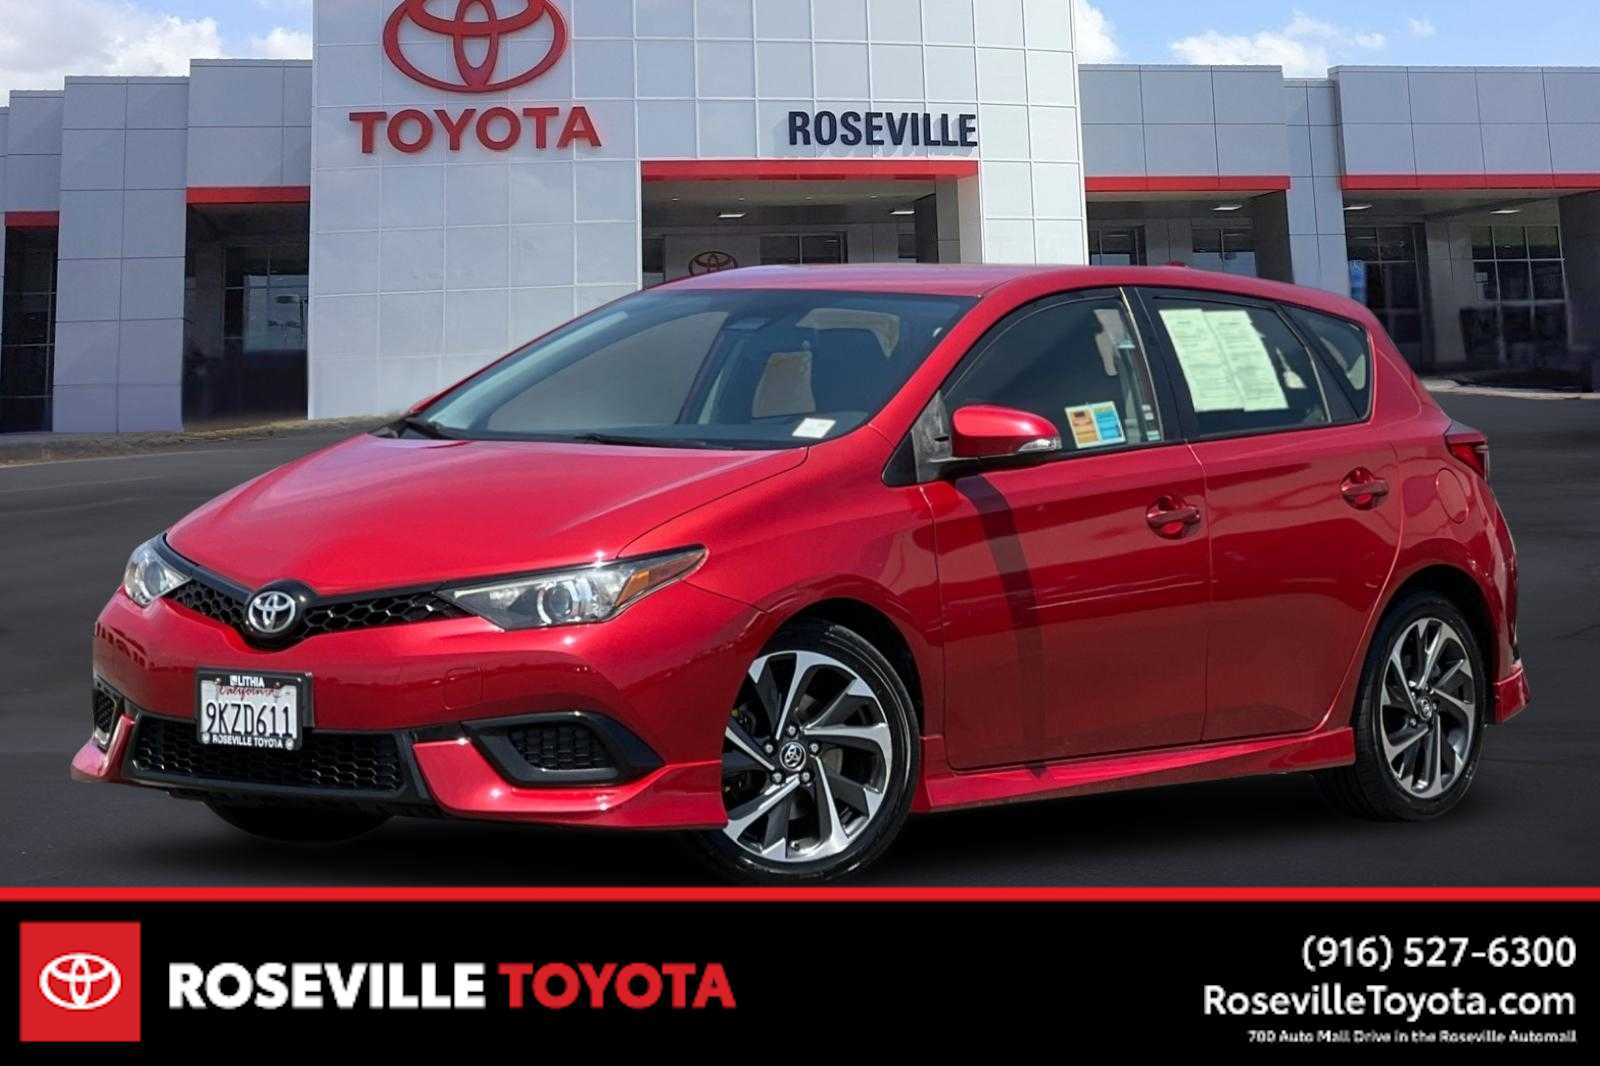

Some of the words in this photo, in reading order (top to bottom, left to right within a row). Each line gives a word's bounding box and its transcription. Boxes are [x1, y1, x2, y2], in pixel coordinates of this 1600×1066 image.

[349, 106, 603, 153] TOYOTA
[788, 110, 978, 147] ROSEVILLE
[238, 675, 265, 687] LITHIA
[206, 702, 293, 738] 9KZD611
[212, 734, 252, 747] ROSEVILLE
[254, 737, 283, 749] TOYOTA
